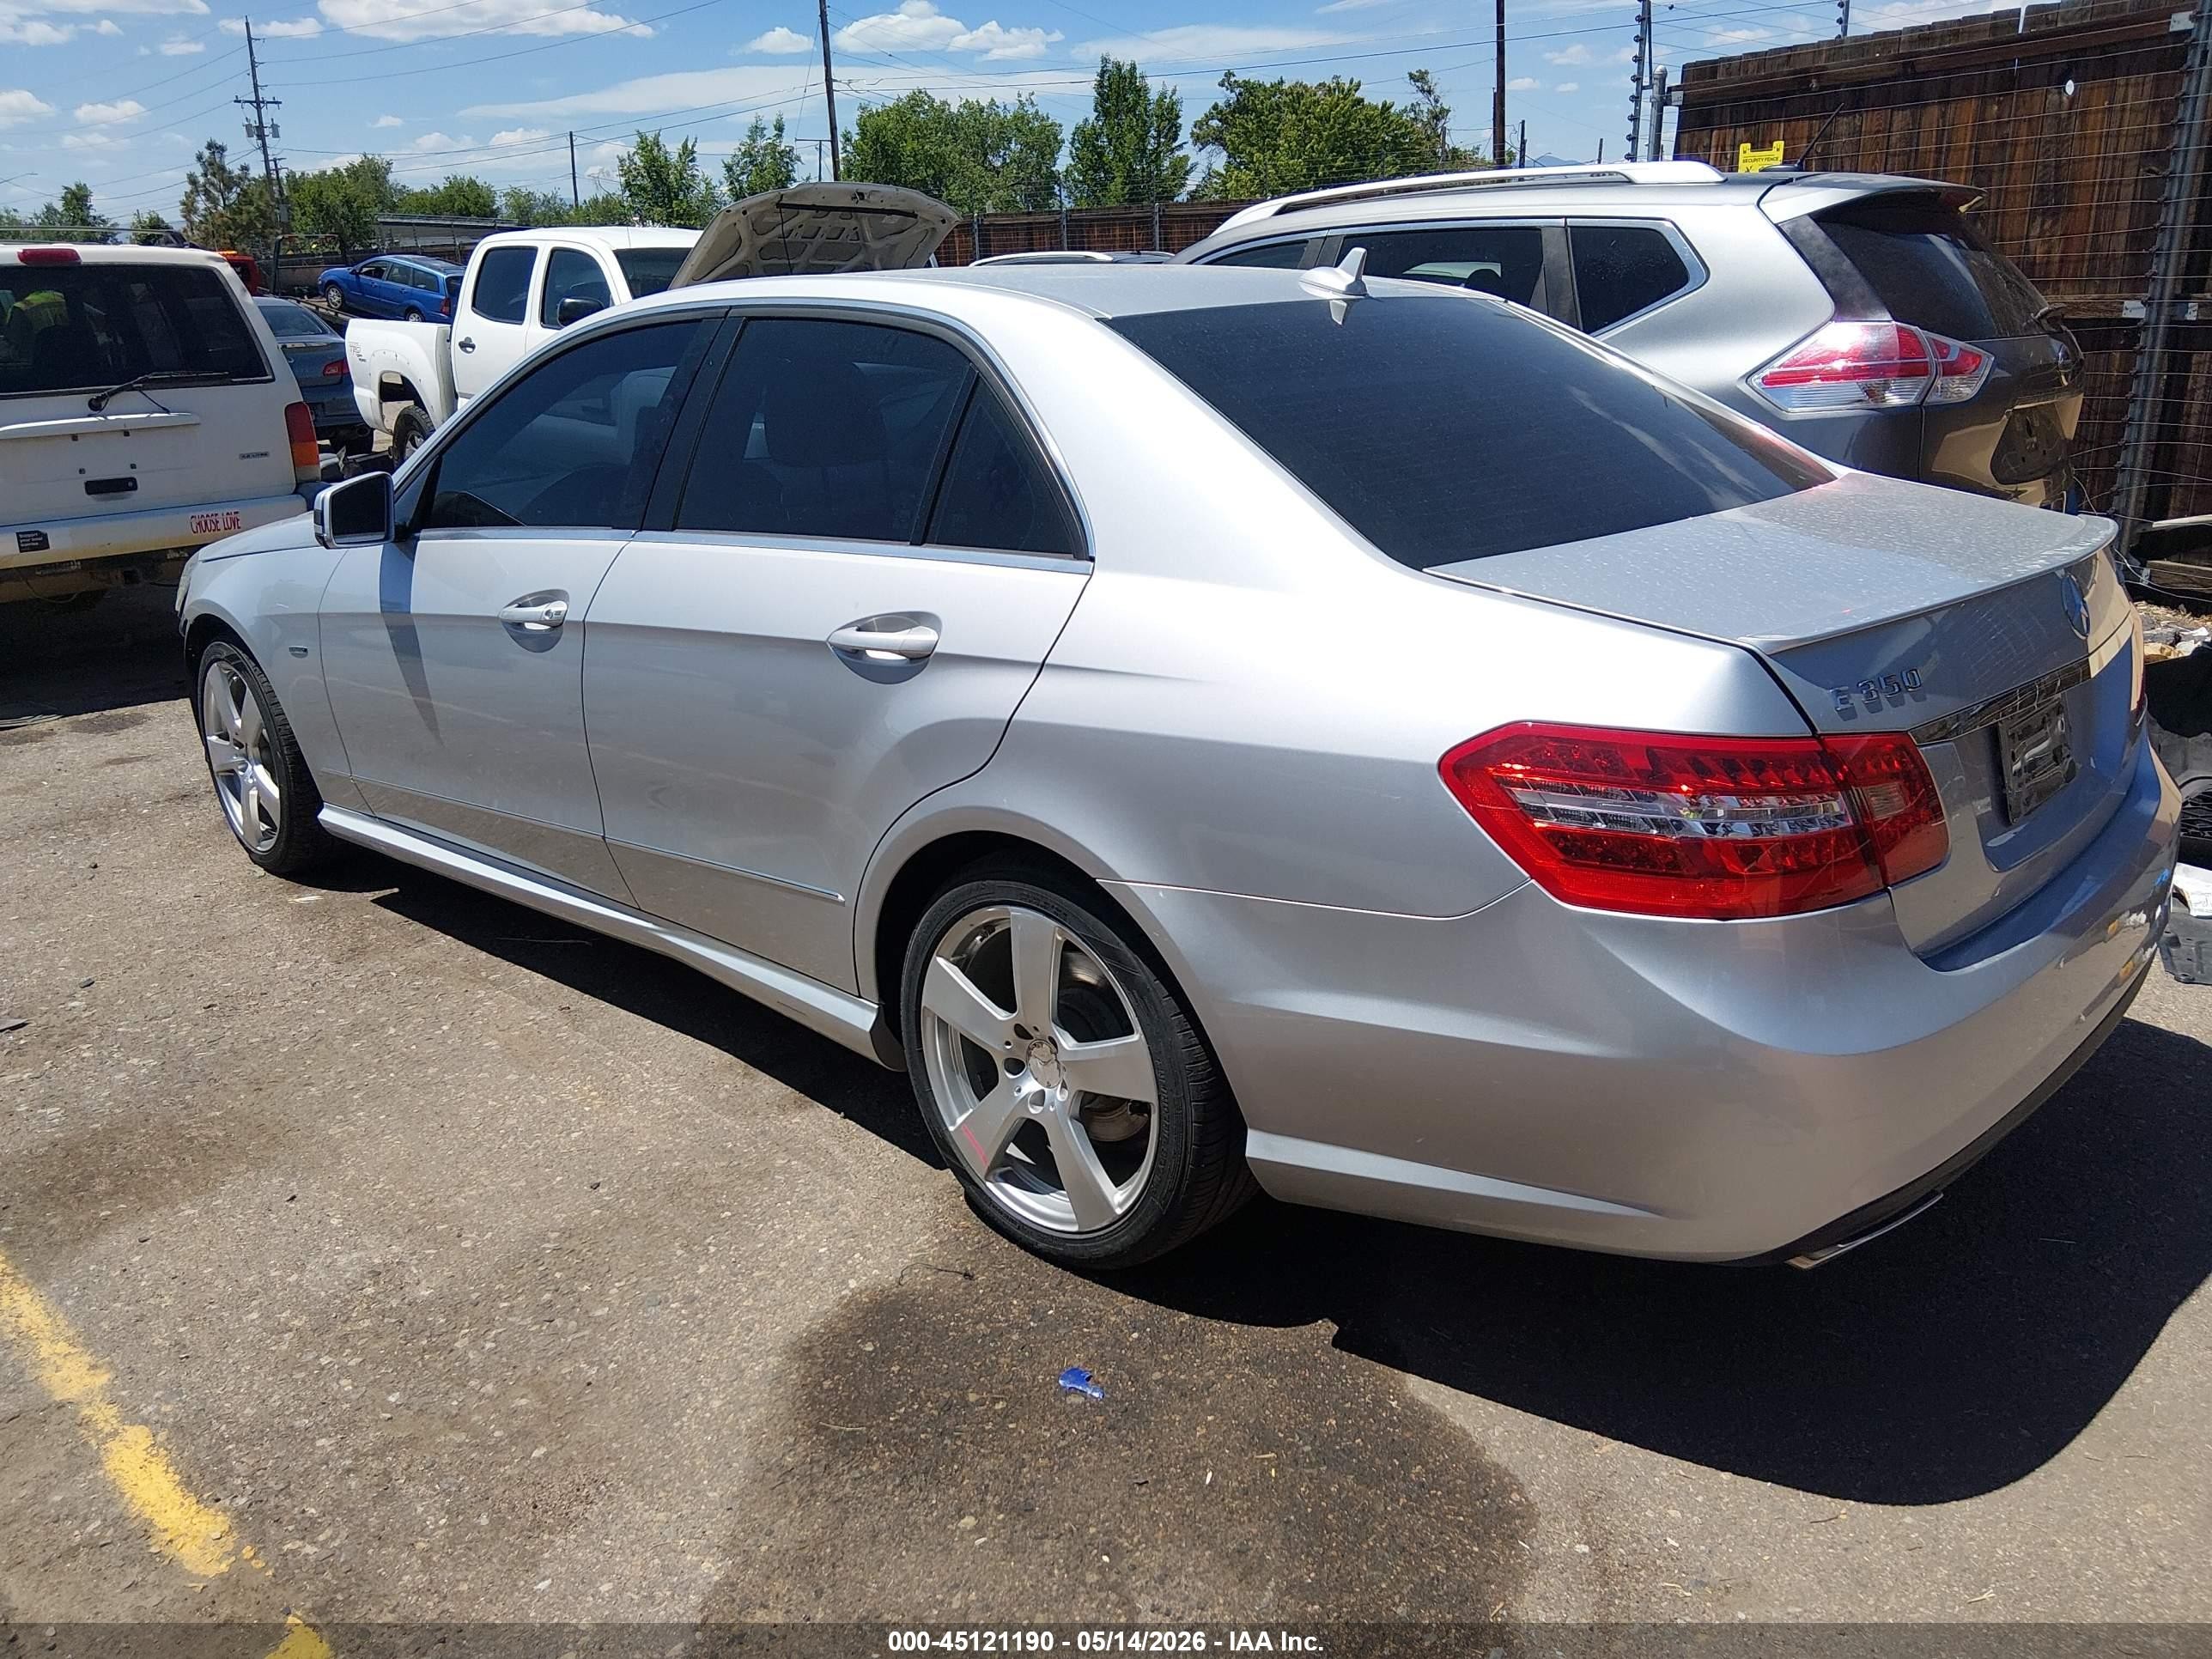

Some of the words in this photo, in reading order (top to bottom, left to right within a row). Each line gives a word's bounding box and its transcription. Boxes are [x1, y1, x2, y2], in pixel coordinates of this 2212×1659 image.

[191, 514, 221, 533] CHOOSE
[222, 511, 240, 531] LOVE
[1829, 685, 1855, 712] E
[1856, 669, 1922, 704] 350
